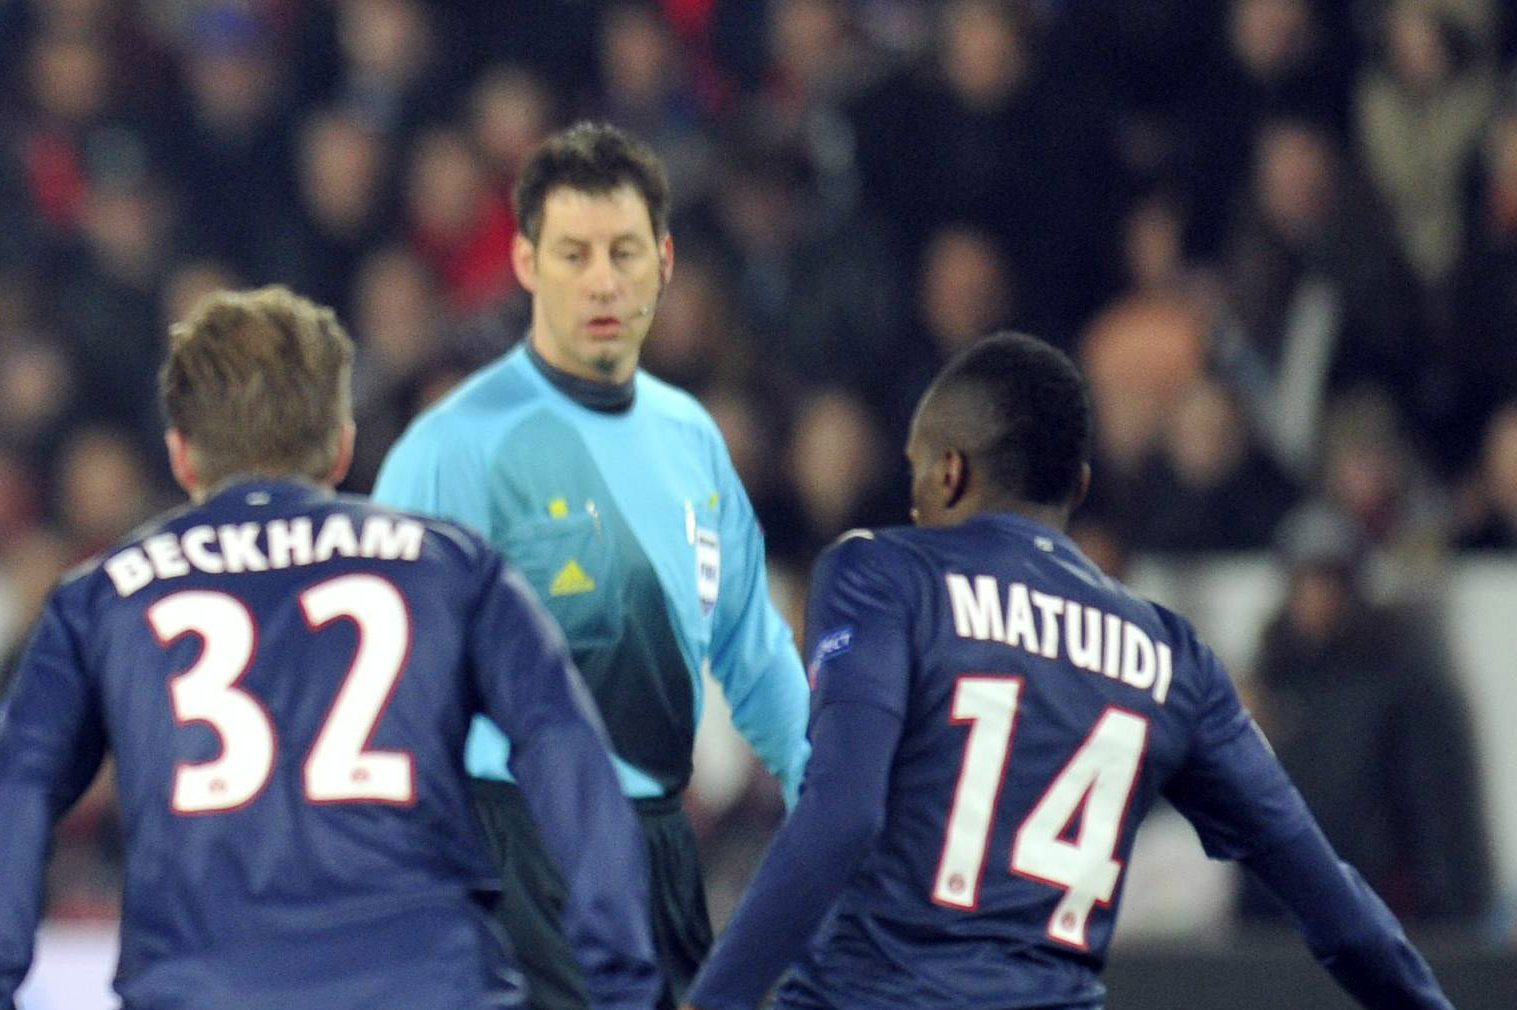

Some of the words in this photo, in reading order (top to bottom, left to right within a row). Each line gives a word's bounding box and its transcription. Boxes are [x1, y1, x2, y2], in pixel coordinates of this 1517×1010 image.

[103, 513, 426, 598] BECKHAM
[945, 573, 1173, 704] MATUIDI
[146, 572, 416, 816] 32
[931, 673, 1150, 952] 14
